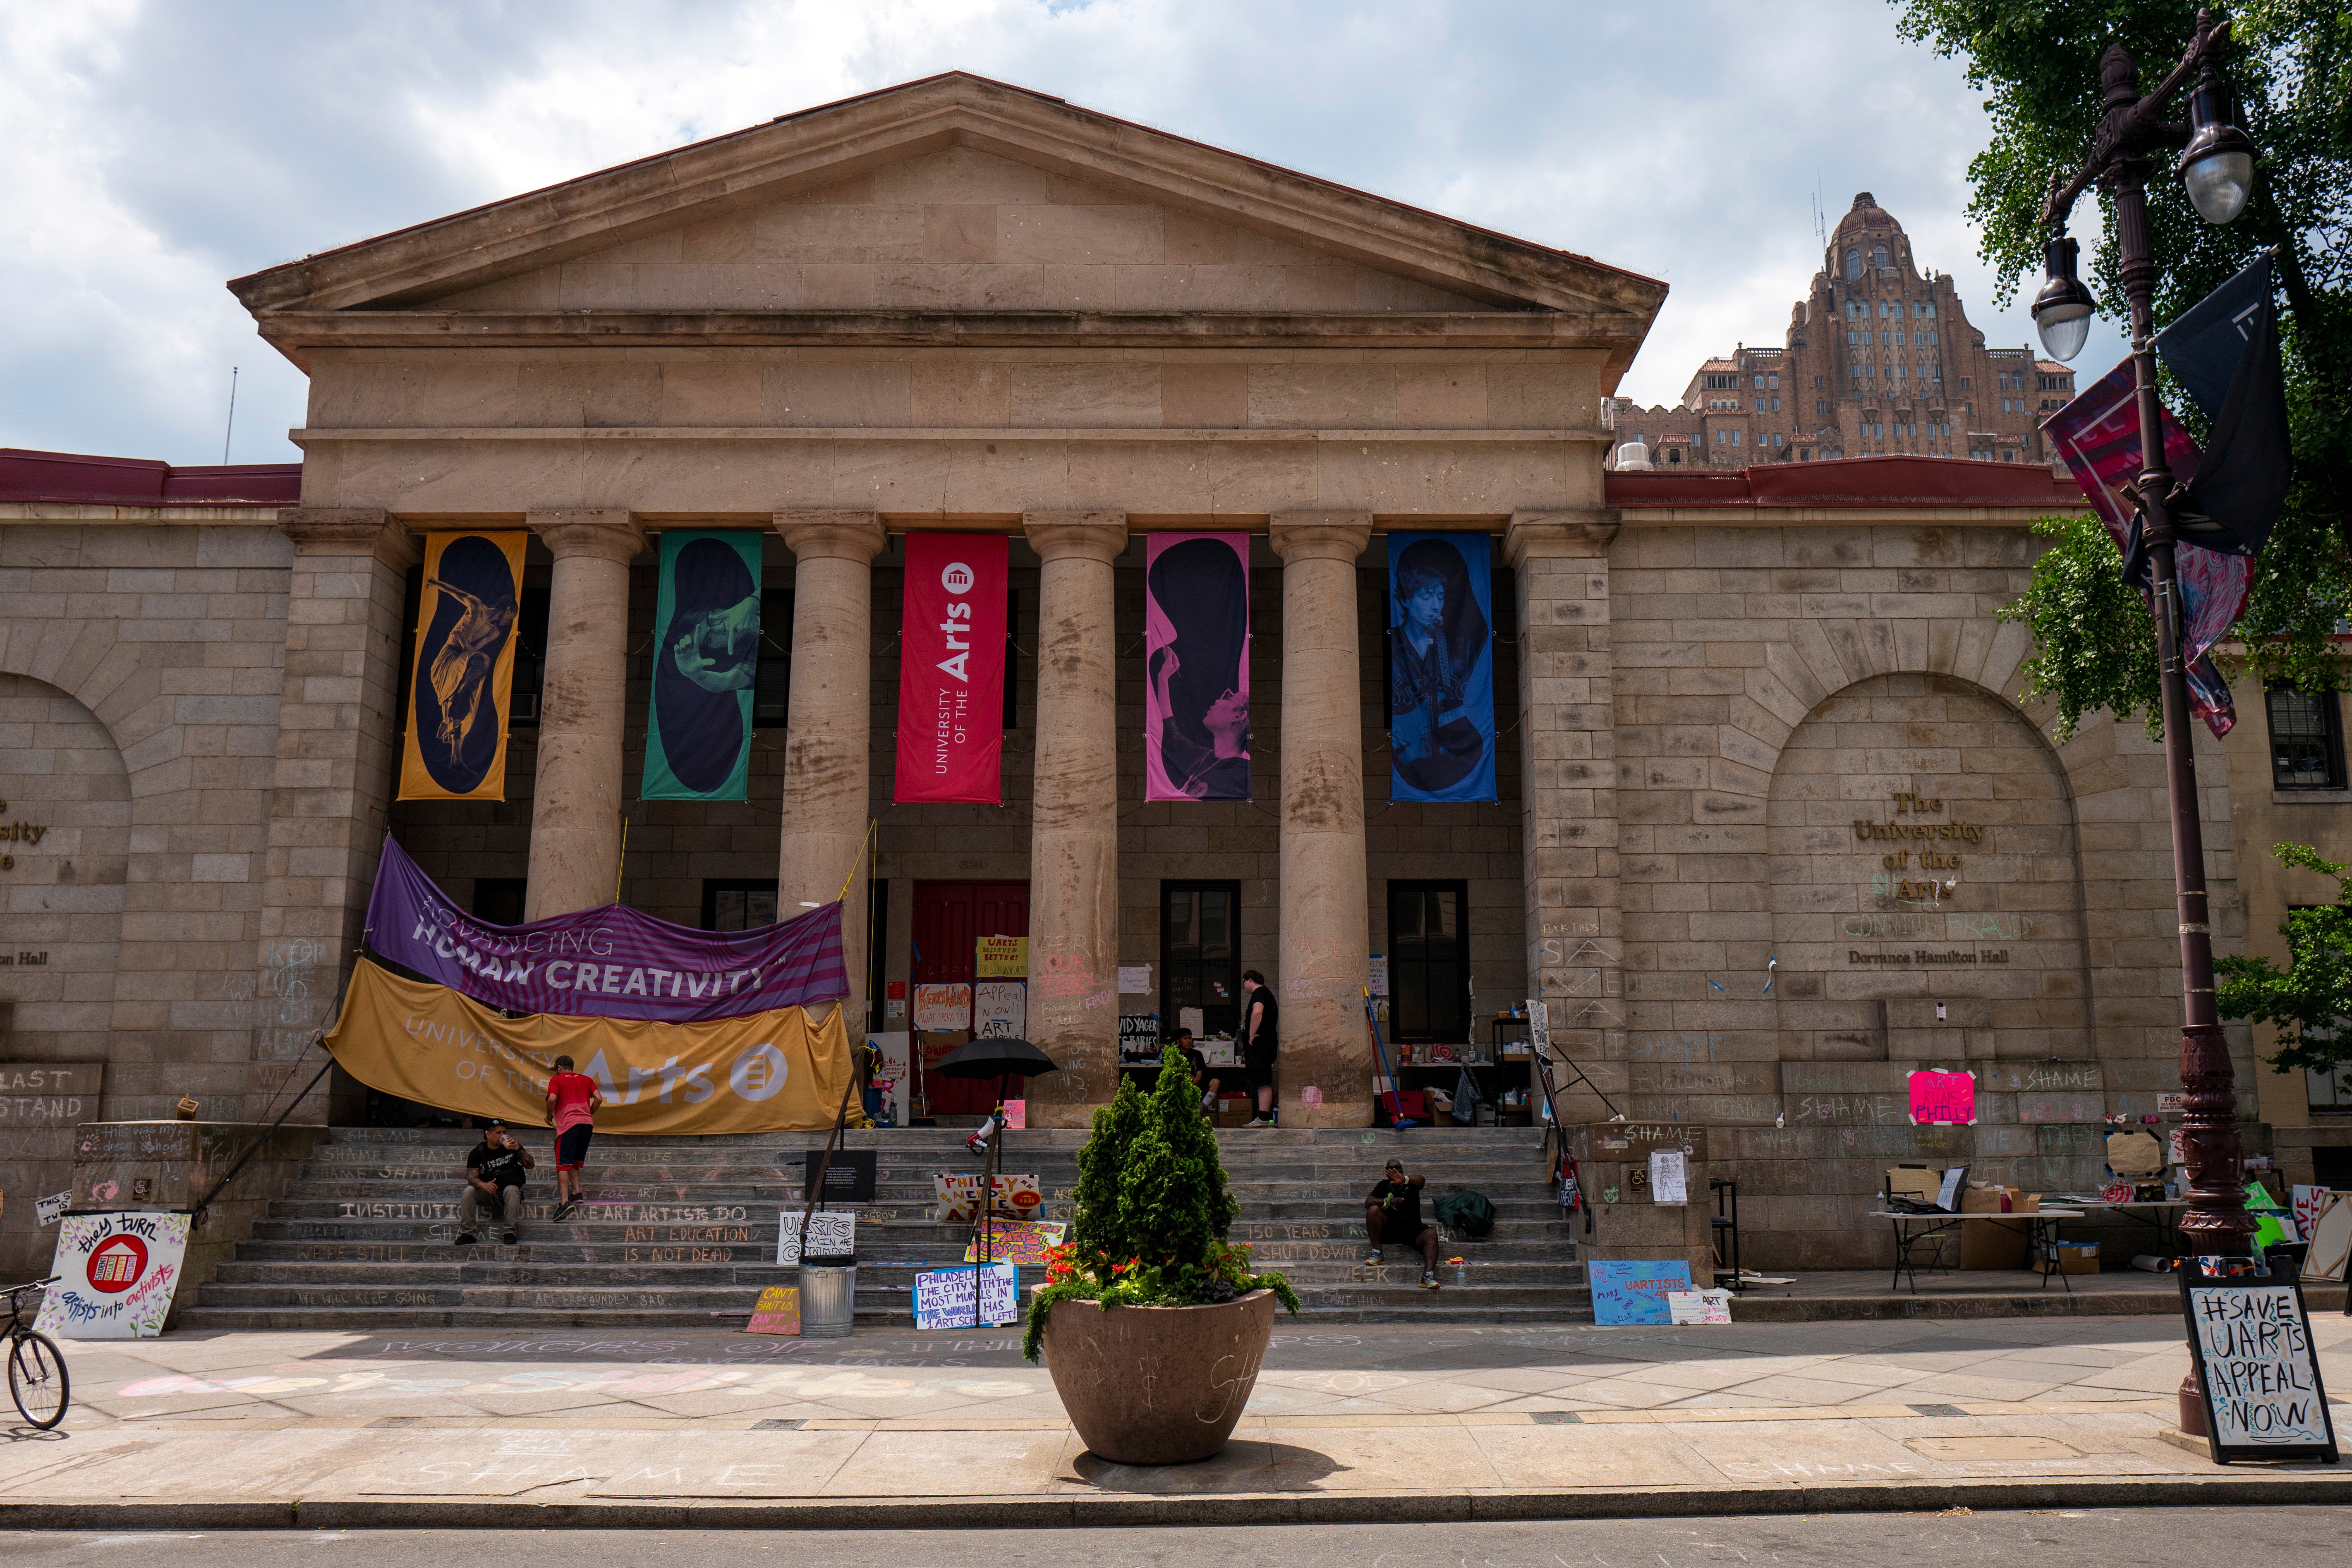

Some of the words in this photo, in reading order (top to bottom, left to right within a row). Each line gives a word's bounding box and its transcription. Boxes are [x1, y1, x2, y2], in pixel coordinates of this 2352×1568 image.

[936, 602, 971, 683] Arts
[956, 690, 967, 719] THE
[936, 688, 951, 774] UNIVERSITY
[954, 729, 966, 743] OF
[1893, 792, 1944, 812] The
[1853, 820, 1985, 843] University
[1883, 849, 1909, 869] of
[1920, 849, 1961, 869] the
[423, 895, 613, 956] ADVANCING
[17, 951, 48, 965] Hall
[412, 914, 535, 985] HUMAN
[546, 960, 773, 997] CREATIVITY
[1046, 954, 1086, 972] OUR
[1848, 950, 1910, 964] Dorrance
[1915, 950, 1976, 963] Hamilton
[1980, 950, 2009, 963] Hall
[917, 1013, 936, 1023] AWAY
[939, 1013, 954, 1022] FROM
[957, 1012, 968, 1022] US!
[1134, 1017, 1157, 1032] YAGER
[982, 1021, 1013, 1036] ART
[405, 1016, 558, 1070] UNIVERSITY
[456, 1060, 493, 1082] OF
[503, 1069, 548, 1096] THE
[581, 1047, 715, 1104] Arts
[1924, 1075, 1960, 1089] ART
[2026, 1068, 2098, 1090] SHAME
[1923, 1090, 1962, 1106] RUNS
[1795, 1096, 1897, 1120] SHAME
[1916, 1105, 1974, 1123] PHILLY
[101, 1125, 128, 1139] this
[133, 1125, 156, 1135] was
[344, 1130, 423, 1143] SHAME
[1624, 1124, 1706, 1142] SHAME
[319, 1147, 381, 1162] SHAME
[378, 1166, 453, 1180] SHAME
[944, 1176, 1018, 1192] PHILLY
[598, 1189, 628, 1199] FOR
[637, 1186, 661, 1200] ART
[953, 1189, 1008, 1199] NEEDS
[38, 1195, 61, 1209] THIS
[58, 1200, 68, 1210] IS
[604, 1204, 634, 1221] ART
[869, 1209, 898, 1220] GROW
[77, 1217, 112, 1254] they
[625, 1226, 655, 1242] ART
[670, 1227, 748, 1242] EDUCATION
[1248, 1224, 1274, 1240] 150
[1284, 1224, 1329, 1240] YEARS
[839, 1237, 853, 1246] ARE
[357, 1246, 411, 1262] STILL
[625, 1247, 639, 1262] IS
[652, 1247, 685, 1262] NOT
[692, 1247, 733, 1262] DEAD
[1258, 1245, 1301, 1261] SHUT
[1309, 1245, 1357, 1260] DOWN
[94, 1257, 108, 1280] STUDENT
[114, 1257, 126, 1281] STAFF
[126, 1264, 175, 1306] activists
[918, 1286, 940, 1297] THE
[944, 1282, 967, 1293] CITY
[1624, 1278, 1686, 1290] UARTISTS
[298, 1292, 315, 1305] WE
[356, 1291, 388, 1305] KEEP
[764, 1287, 798, 1299] CAN'T
[921, 1293, 952, 1309] MOST
[997, 1287, 1008, 1298] IN
[1597, 1288, 1619, 1300] MARS
[1702, 1295, 1721, 1306] ART
[101, 1300, 123, 1320] into
[757, 1300, 782, 1311] SHUT
[781, 1301, 794, 1311] US
[918, 1308, 940, 1322] THE
[942, 1303, 977, 1317] WORLD
[984, 1300, 1005, 1313] HAS
[2201, 1293, 2294, 1321] #SAVE
[751, 1313, 786, 1325] CAN'T
[935, 1317, 956, 1328] ART
[957, 1314, 989, 1326] SCHOL
[992, 1307, 1016, 1321] LEFT!
[1618, 1312, 1633, 1321] ELLE
[725, 1340, 838, 1354] OF
[2210, 1321, 2306, 1358] UARTS
[2214, 1361, 2311, 1398] APPEAL
[2231, 1398, 2310, 1432] NOW
[1723, 1461, 1919, 1479] SHAME
